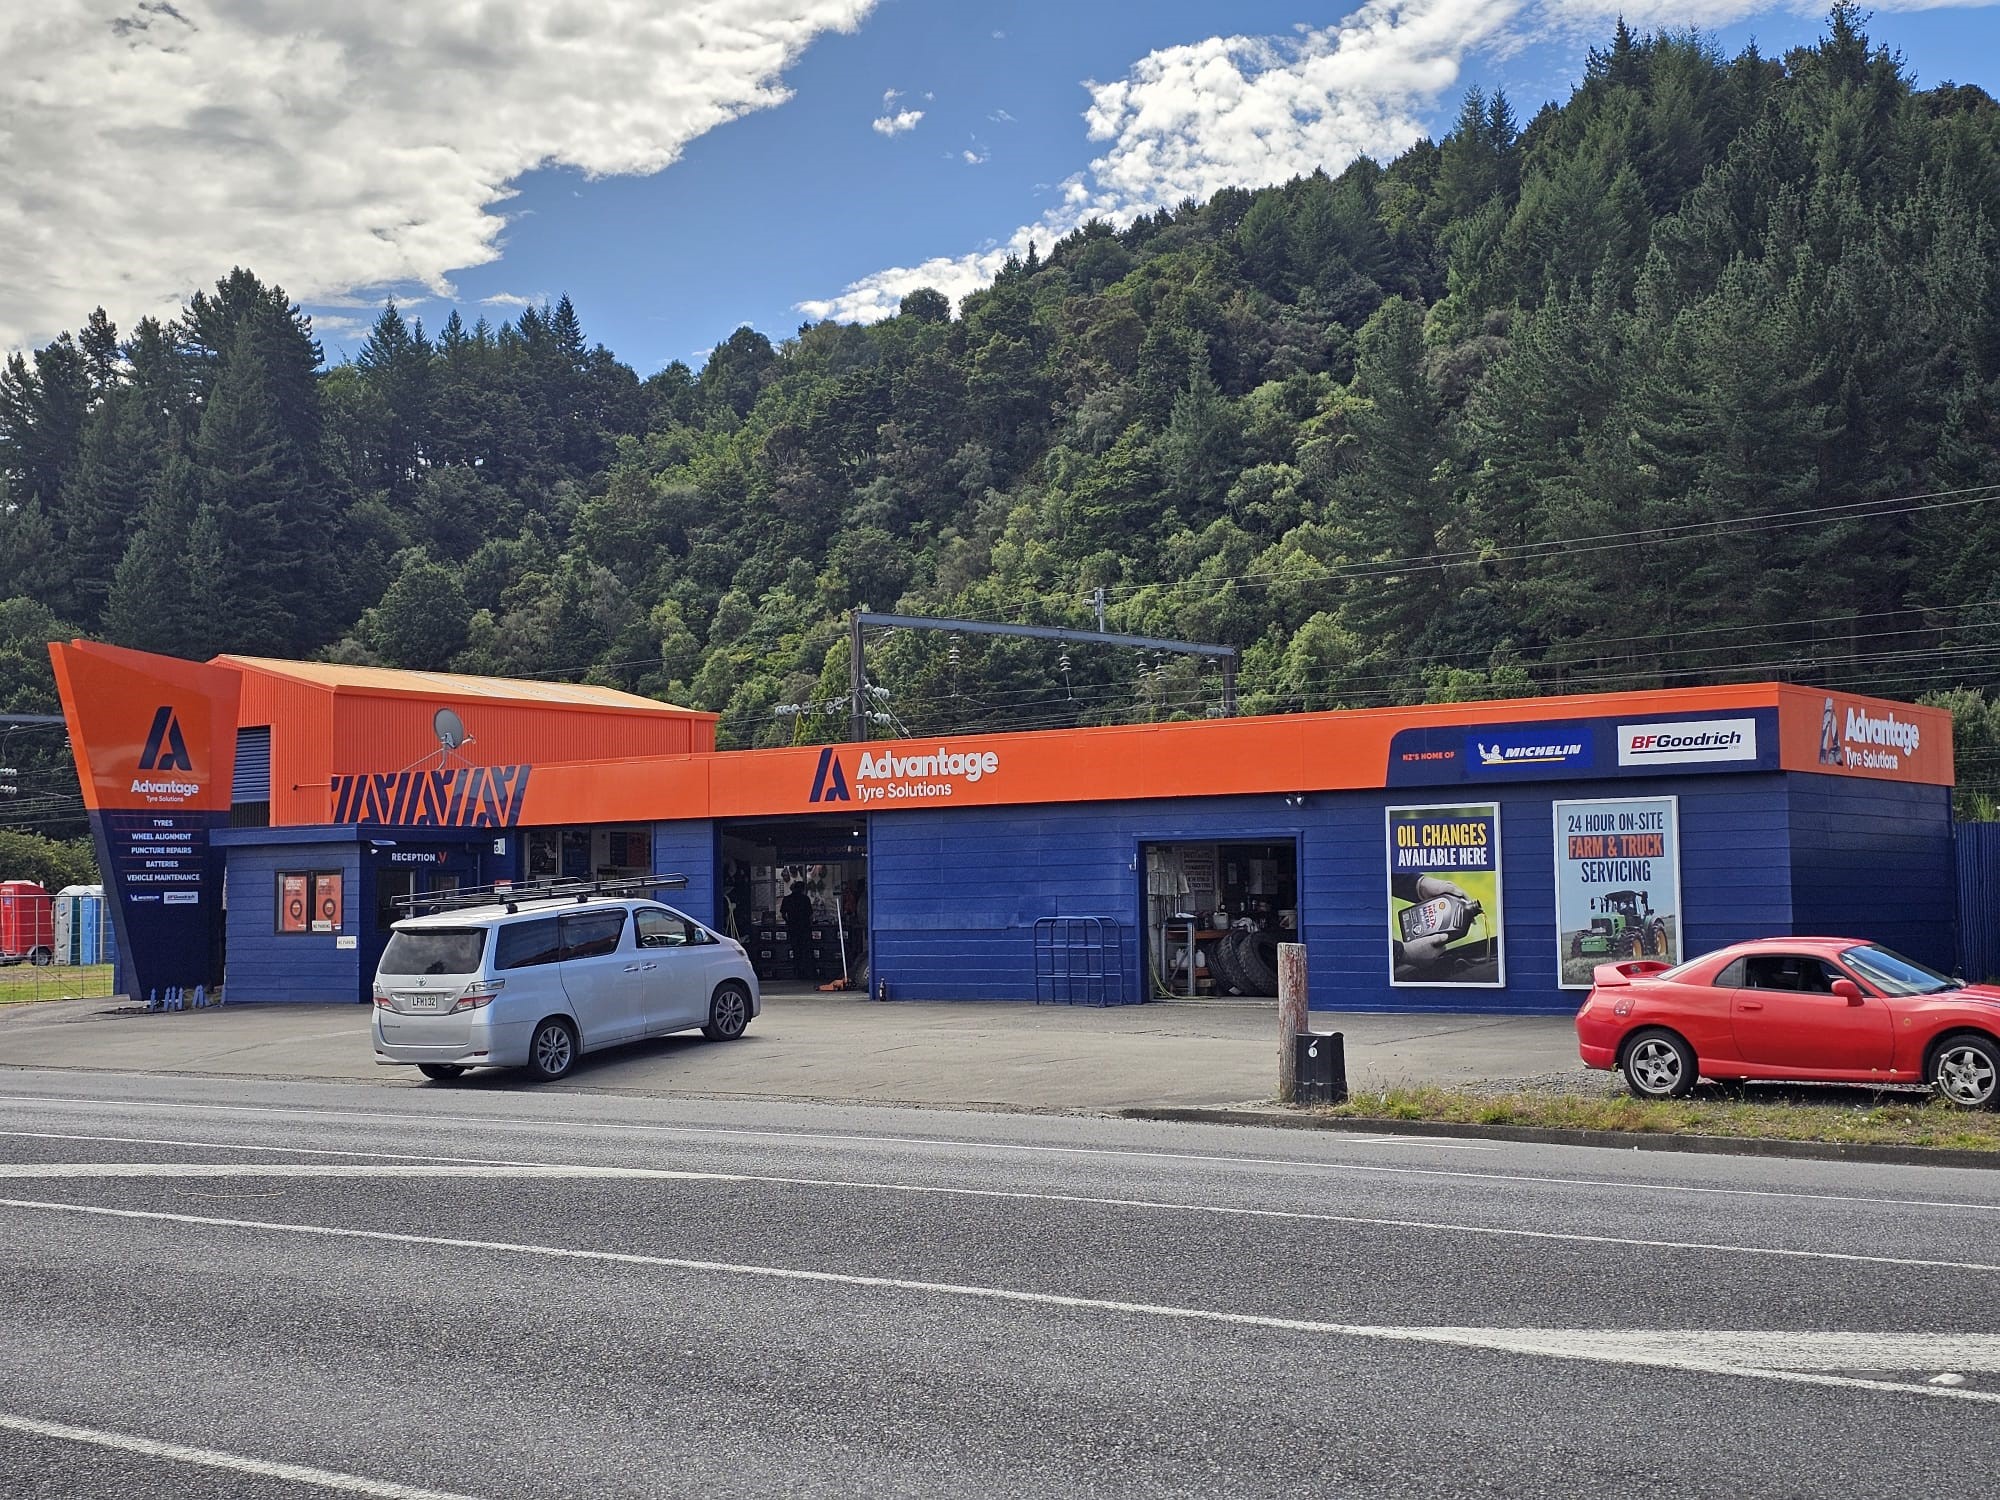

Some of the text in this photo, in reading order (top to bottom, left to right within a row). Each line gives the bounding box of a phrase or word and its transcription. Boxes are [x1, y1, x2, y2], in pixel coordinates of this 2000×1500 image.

[1631, 731, 1741, 749] BFGoodrich
[1845, 707, 1919, 756] Advantage
[1403, 751, 1455, 761] NZ'S HOME OF
[1505, 744, 1582, 758] MICHELIN
[1845, 746, 1898, 770] Tyre Solutions
[856, 747, 999, 782] Advantage
[131, 780, 199, 796] Advantage
[856, 781, 952, 803] Tyre Solutions
[1568, 812, 1664, 832] 24 HOUR ON-SITE
[1397, 823, 1487, 847] OIL CHANGES
[1398, 847, 1487, 866] AVAILABLE HERE
[1569, 834, 1663, 858] FARM & TRUCK
[391, 853, 435, 861] RECEPTION
[1581, 860, 1651, 882] SERVICING
